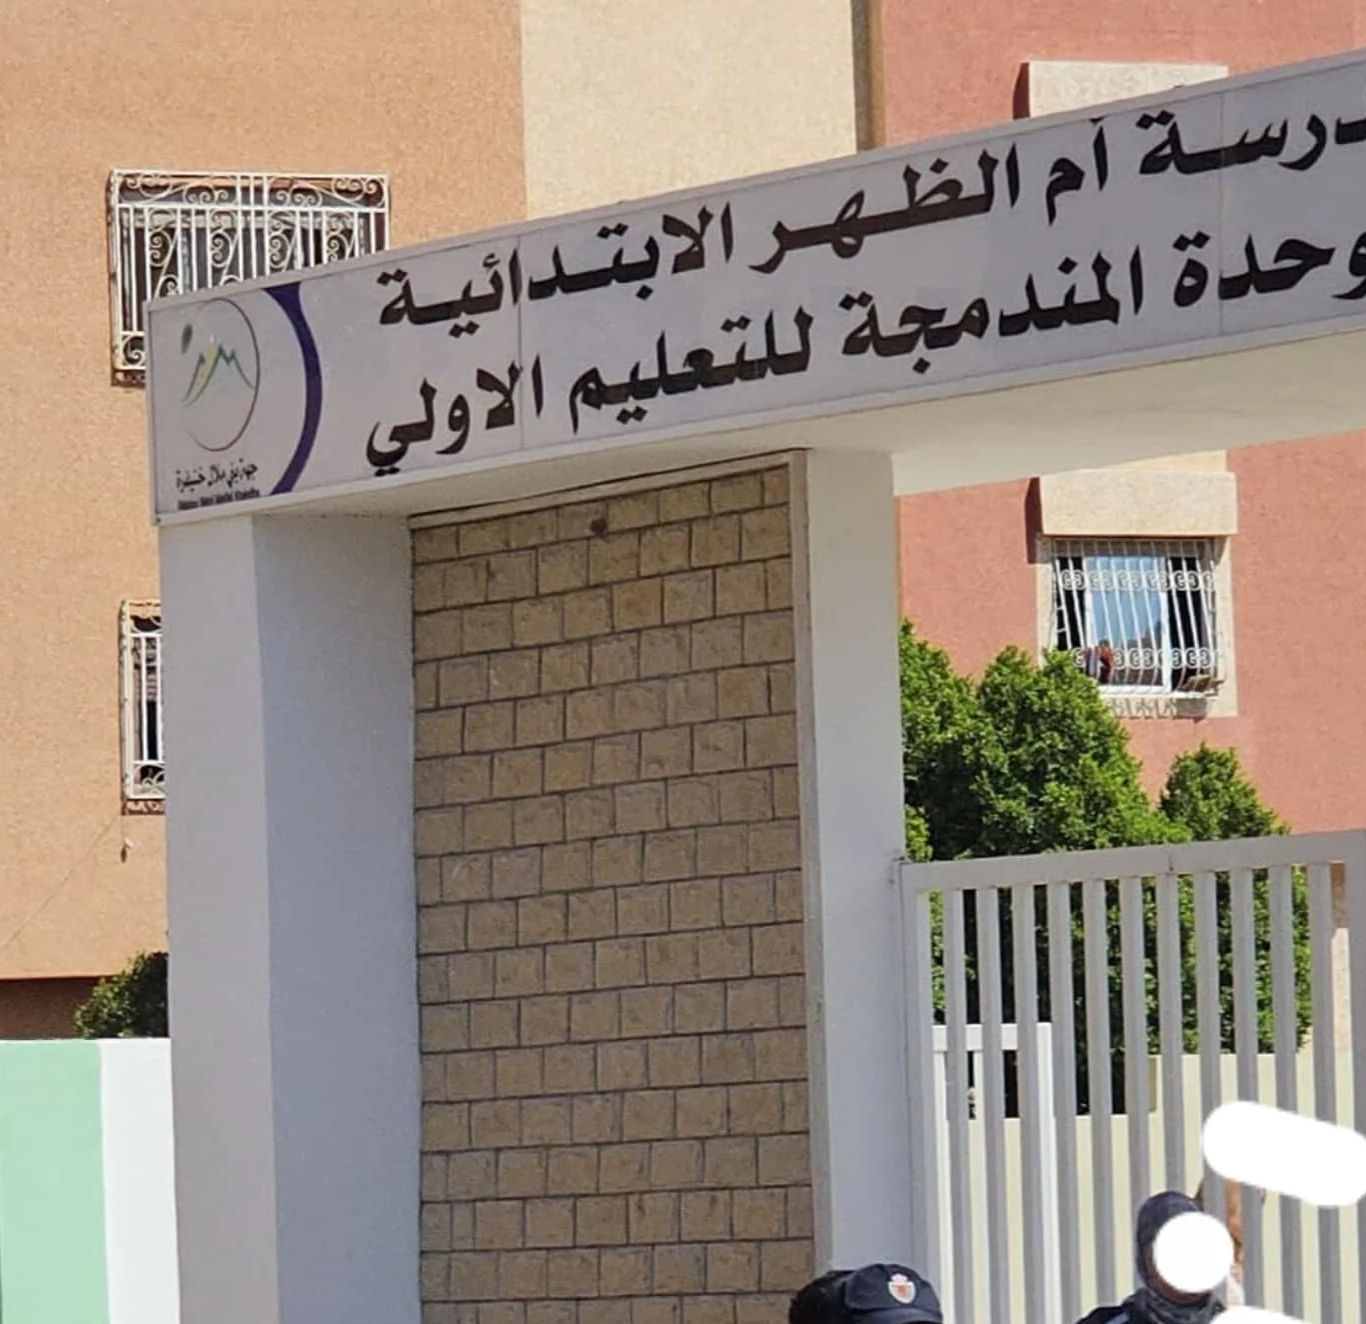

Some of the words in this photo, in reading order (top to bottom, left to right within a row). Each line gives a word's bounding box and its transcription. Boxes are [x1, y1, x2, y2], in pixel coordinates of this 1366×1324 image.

[377, 203, 734, 339] الابتدائية
[749, 143, 1021, 275] الظهر
[569, 306, 814, 434] للتعليم
[839, 245, 1144, 375] المندمجة
